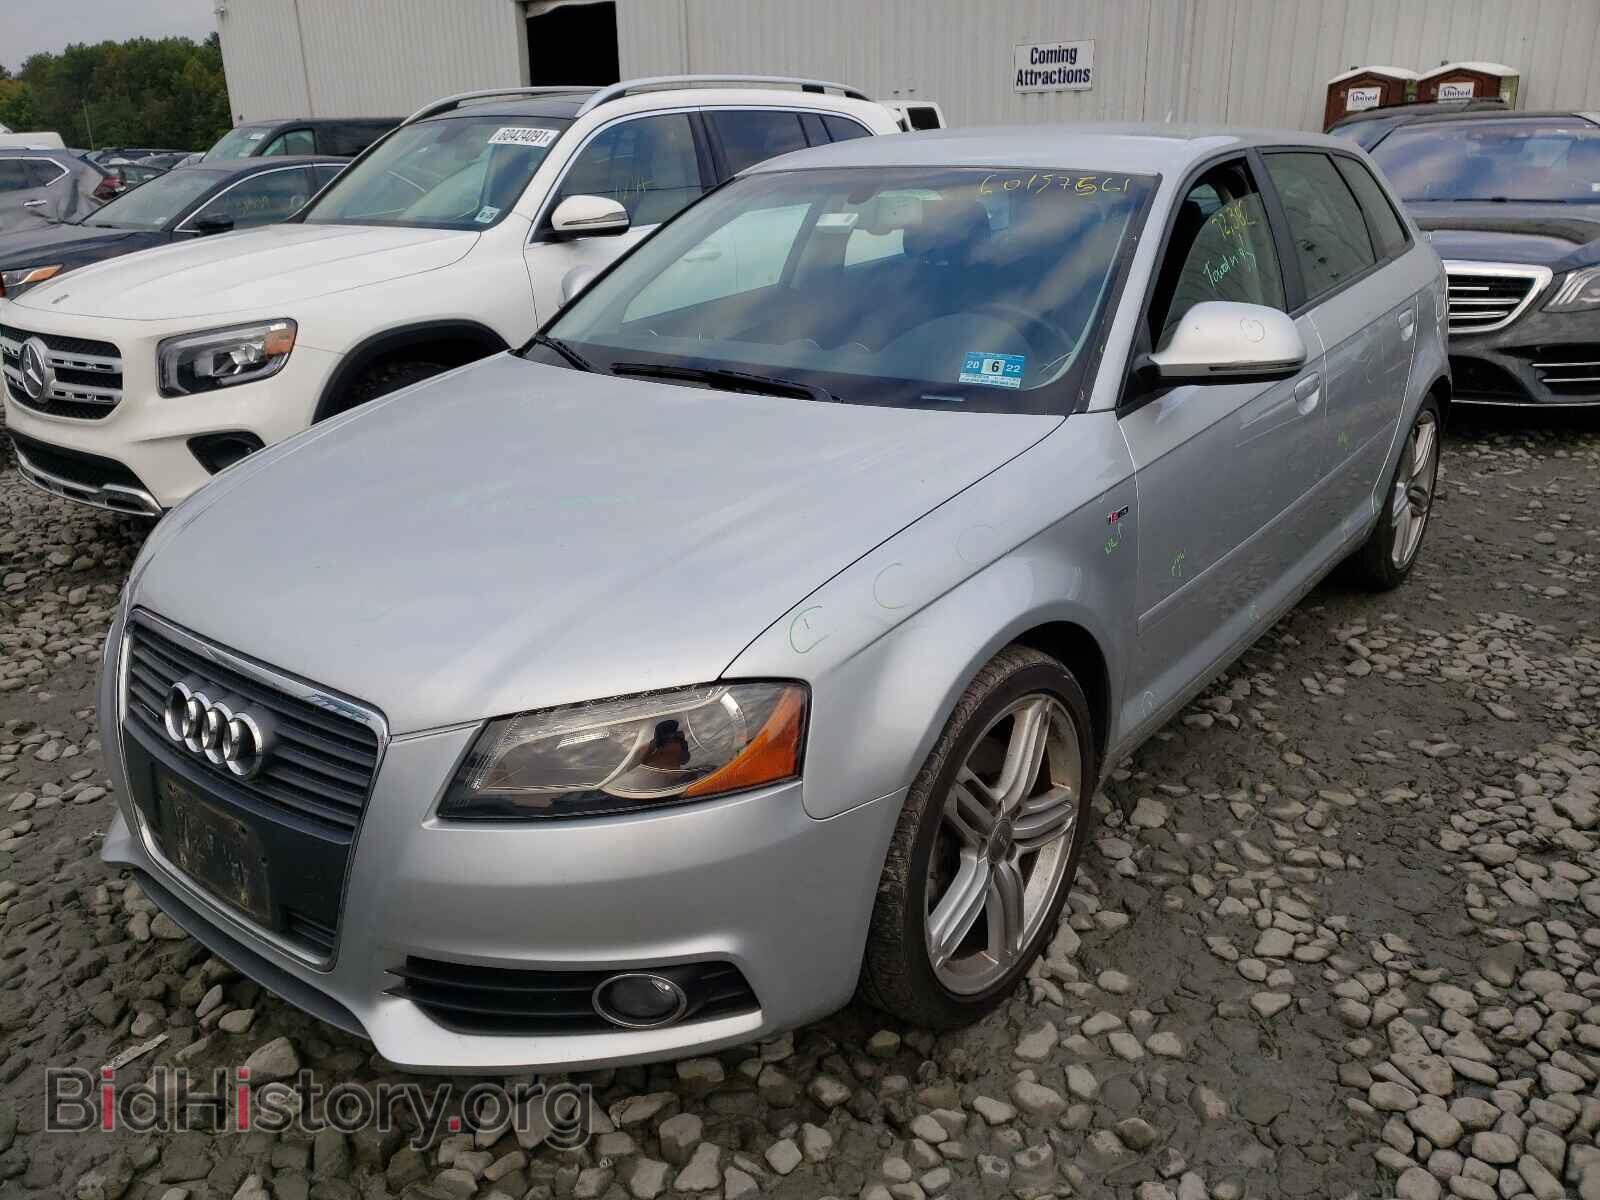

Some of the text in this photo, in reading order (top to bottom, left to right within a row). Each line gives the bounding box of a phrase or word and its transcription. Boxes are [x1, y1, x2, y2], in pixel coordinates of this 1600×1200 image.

[1030, 45, 1078, 65] Coming
[1016, 66, 1091, 87] Attractions
[1351, 92, 1377, 102] United
[1442, 87, 1471, 98] United
[966, 360, 1020, 373] 20 6 22
